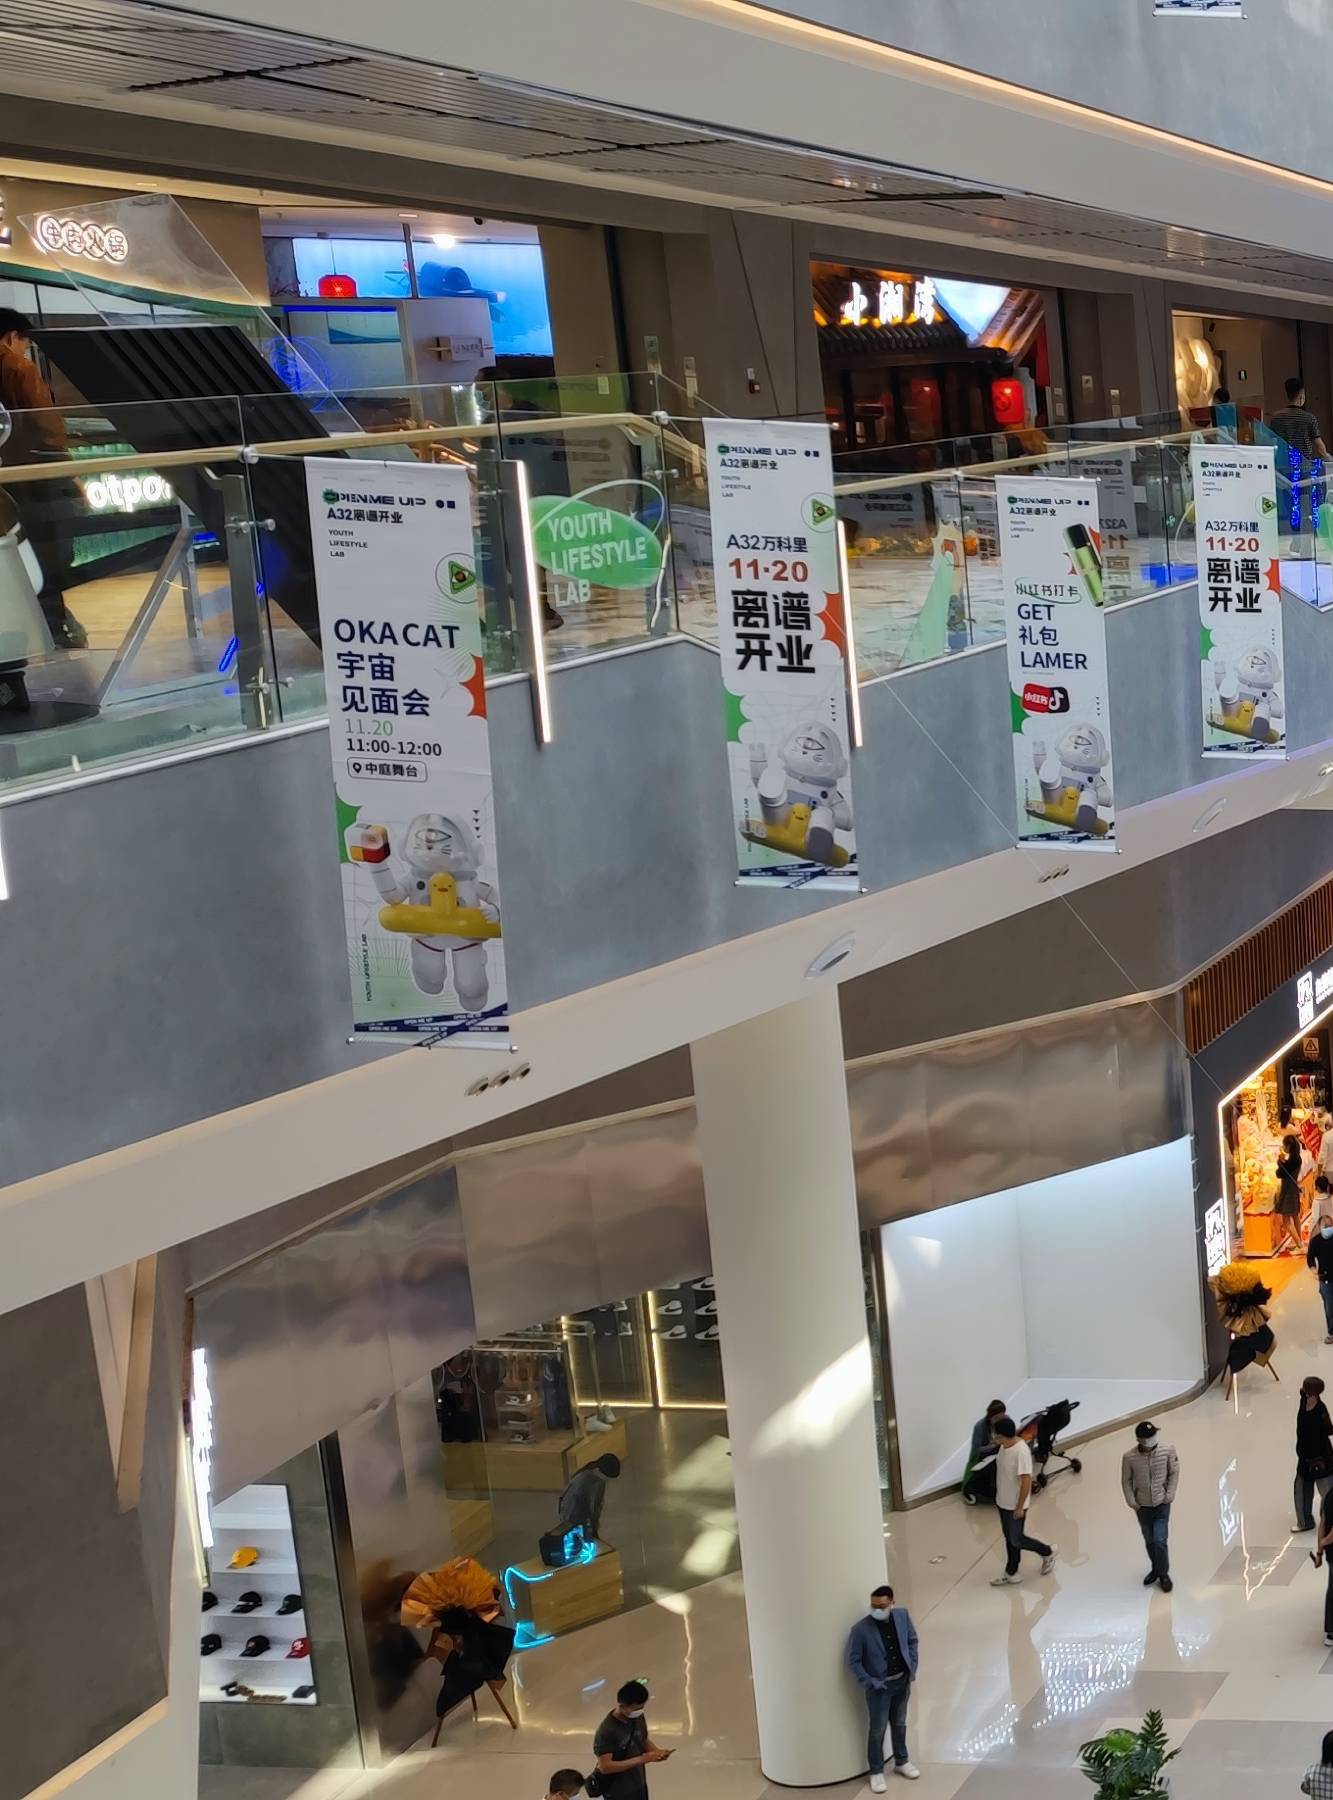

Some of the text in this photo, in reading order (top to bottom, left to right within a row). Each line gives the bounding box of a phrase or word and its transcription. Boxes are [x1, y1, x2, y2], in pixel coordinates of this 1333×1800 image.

[39, 217, 128, 262] 牛肉火锅
[329, 529, 354, 537] YOUTH
[548, 511, 612, 542] YOUTH
[1205, 521, 1259, 533] A32万科里
[329, 540, 368, 549] LIFESTYLE
[726, 533, 808, 553] A32万科里
[550, 537, 647, 575] LIFESTYLE
[1207, 558, 1261, 586] 离谱
[554, 580, 591, 607] LAB
[1208, 588, 1262, 613] 开业
[732, 590, 812, 631] 离谱
[1017, 603, 1054, 621] GET
[1019, 625, 1059, 647] 礼包
[736, 633, 816, 674] 开业
[1021, 652, 1088, 671] LAMER
[337, 651, 395, 682] 宇宙
[341, 685, 430, 717] 见面会
[345, 718, 393, 737] 11.20
[347, 738, 442, 757] 11:00-12:00
[365, 762, 419, 778] 中庭舞台
